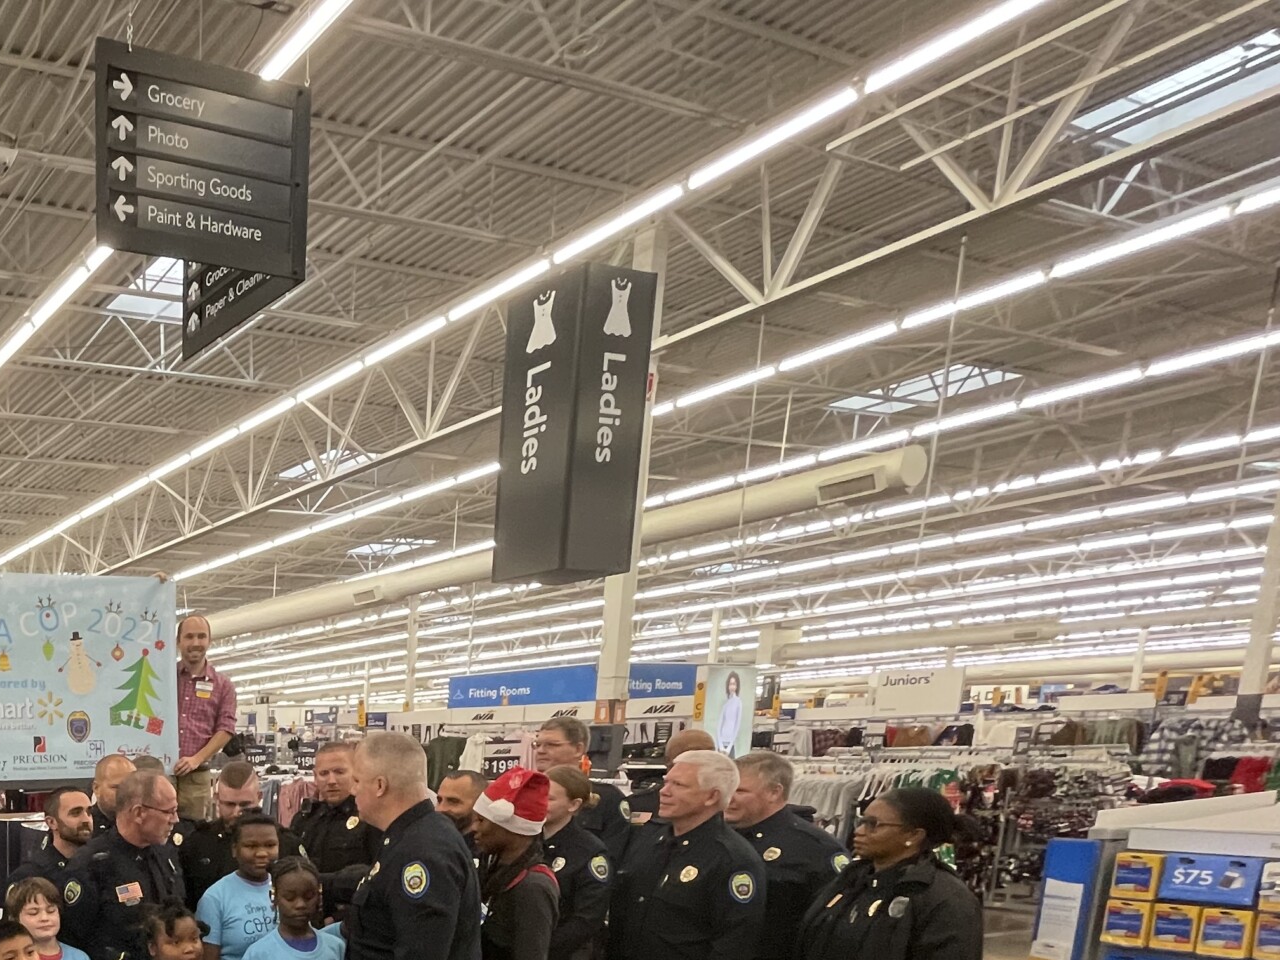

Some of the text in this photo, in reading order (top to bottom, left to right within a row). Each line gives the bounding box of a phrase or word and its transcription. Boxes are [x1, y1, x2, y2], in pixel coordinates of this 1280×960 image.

[147, 84, 206, 117] Grocery
[147, 125, 189, 150] Photo
[147, 166, 252, 202] Sporting Goods
[147, 205, 262, 241] Paint & Hardware
[205, 295, 227, 319] Paper
[227, 287, 235, 302] &
[520, 361, 552, 475] Ladies
[595, 351, 627, 463] Ladies
[20, 602, 78, 637] COP
[31, 678, 46, 690] by
[627, 678, 683, 693] itting Rooms
[882, 672, 935, 687] Juniors'
[468, 686, 531, 700] Fitting Rooms
[643, 703, 676, 714] AVIA
[12, 754, 67, 765] PRECISION
[1172, 867, 1214, 885] $75
